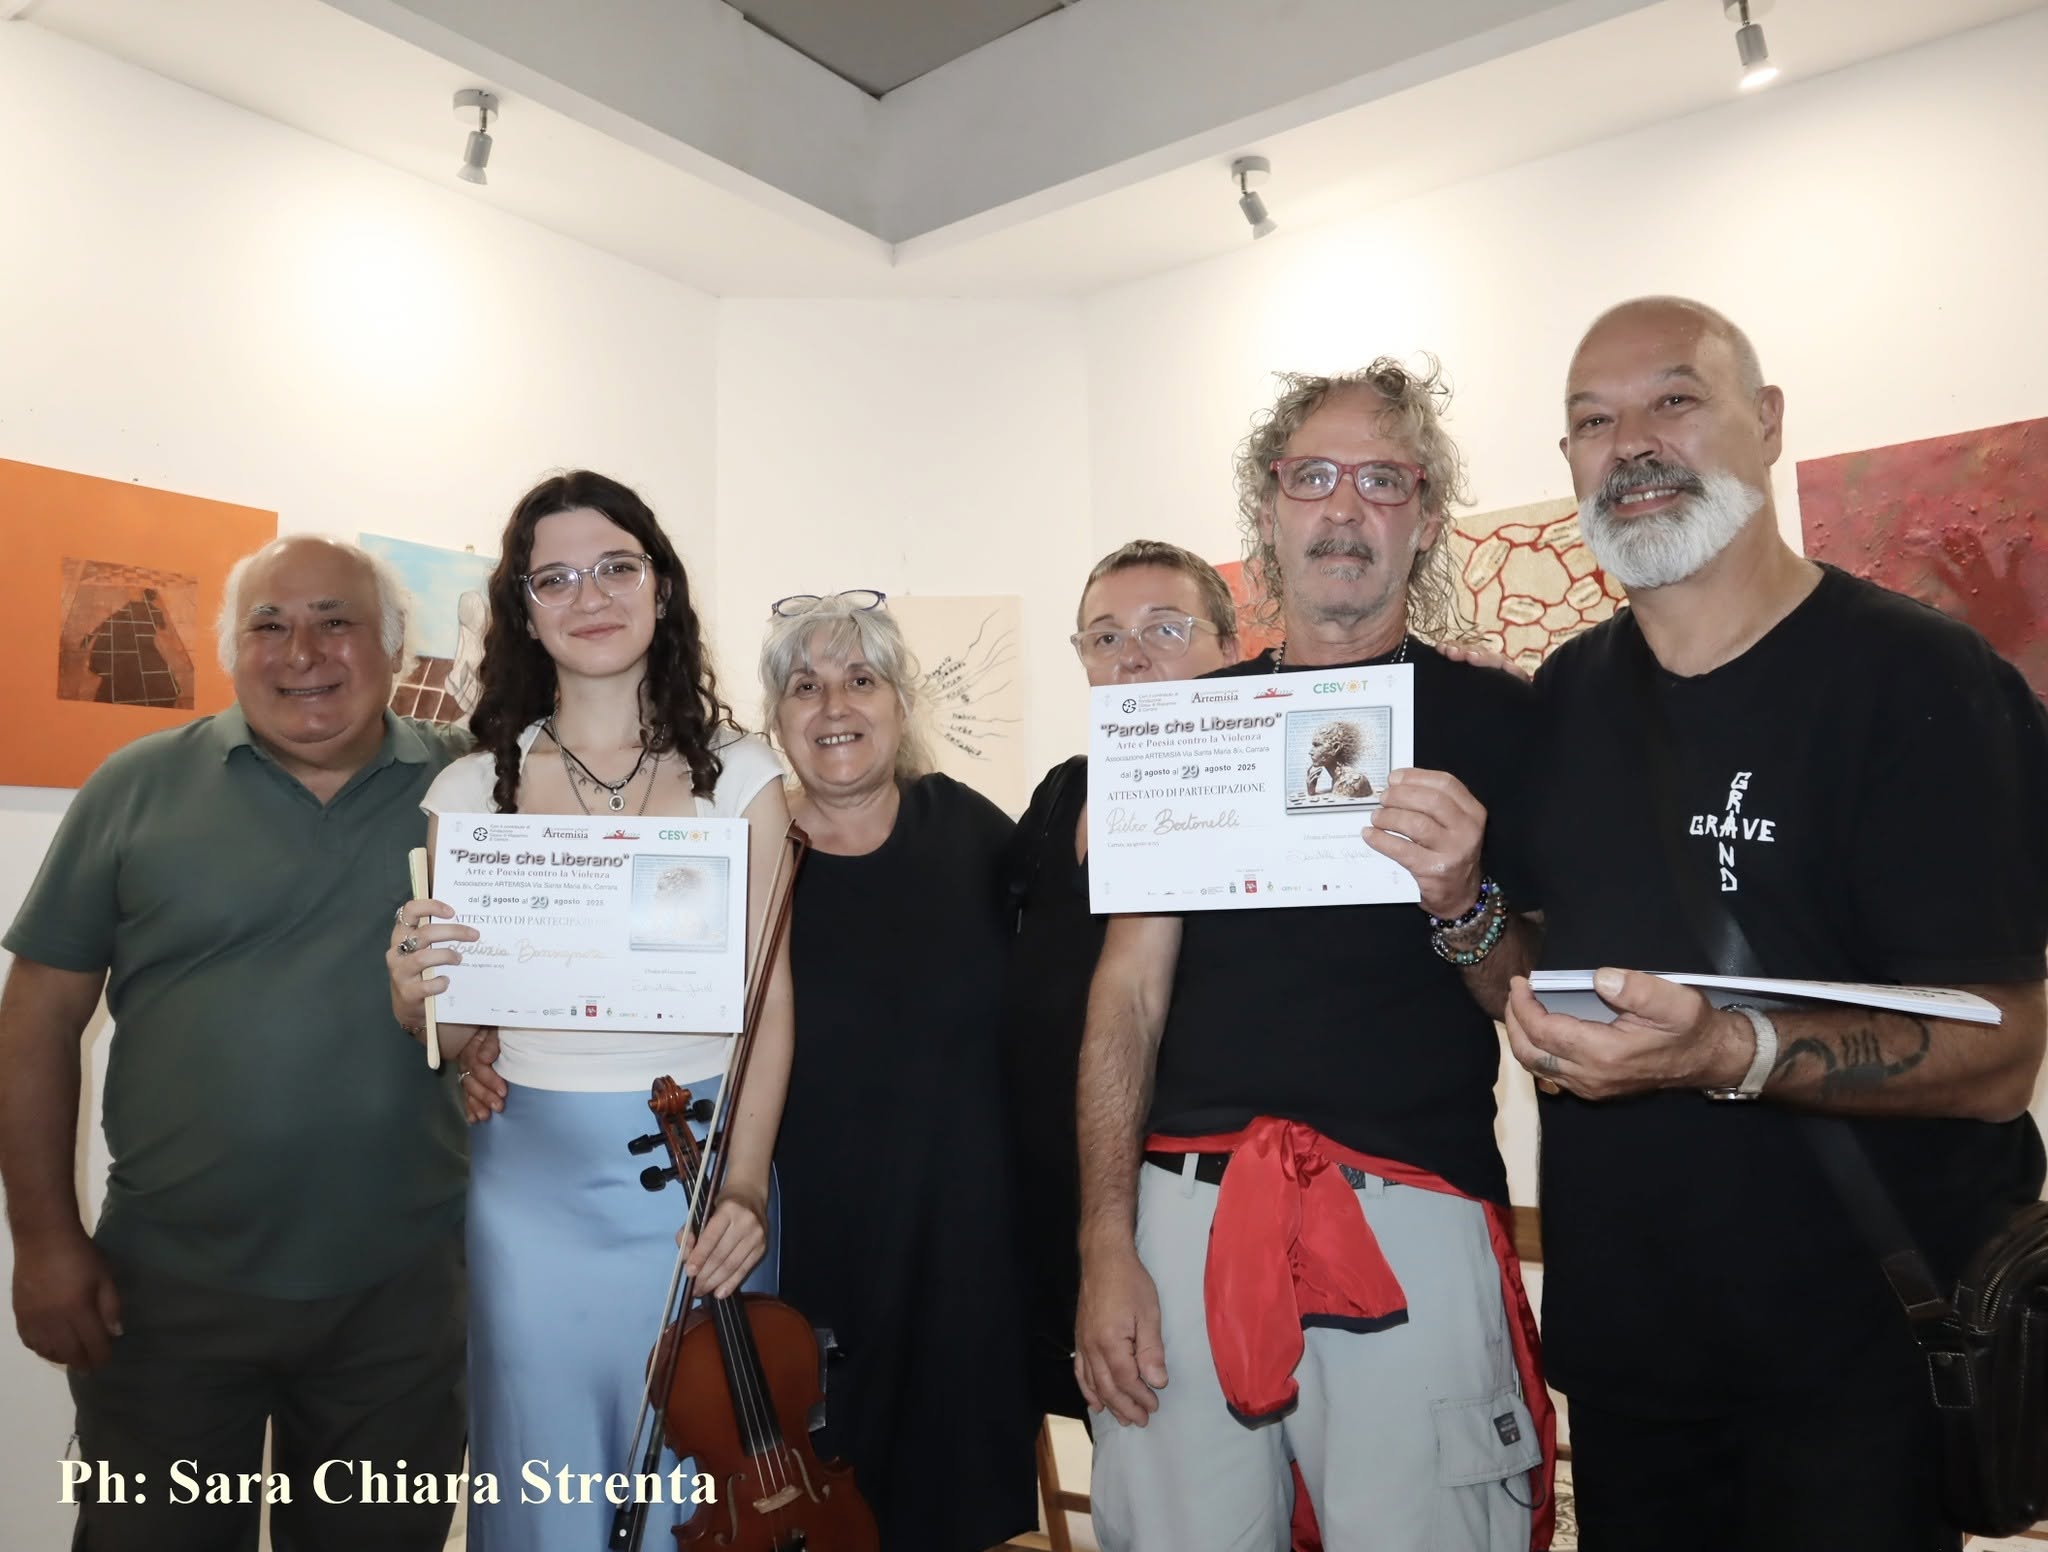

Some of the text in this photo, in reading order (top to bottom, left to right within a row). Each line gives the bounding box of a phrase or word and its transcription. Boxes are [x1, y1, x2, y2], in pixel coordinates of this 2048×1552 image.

[1192, 692, 1239, 704] Artemisia
[1165, 719, 1195, 734] che
[1117, 741, 1136, 750] Arte
[1146, 738, 1175, 748] Poesia
[1178, 736, 1207, 746] contro
[1210, 735, 1218, 744] la
[1221, 733, 1262, 742] Violenza
[1105, 754, 1145, 762] Associazione
[1145, 751, 1182, 760] ARTEMISIA
[1194, 749, 1212, 757] Santa
[1120, 771, 1131, 779] dal
[1144, 768, 1170, 778] agosto
[1171, 767, 1179, 775] al
[1181, 765, 1200, 779] 29
[1204, 764, 1232, 773] agosto
[1237, 763, 1256, 771] 2025
[1107, 782, 1266, 801] ATTESTATO DI PARTECIPAZIONE
[542, 827, 589, 839] Artemisia
[1689, 814, 1776, 842] GRAVE
[516, 851, 546, 865] che
[466, 868, 486, 876] Arte
[496, 868, 526, 877] Poesia
[527, 869, 558, 877] contro
[571, 870, 610, 878] Violenza
[468, 895, 479, 903] dal
[493, 896, 520, 904] agosto
[531, 895, 549, 909] 29
[554, 898, 581, 906] agosto
[514, 915, 527, 925] DI
